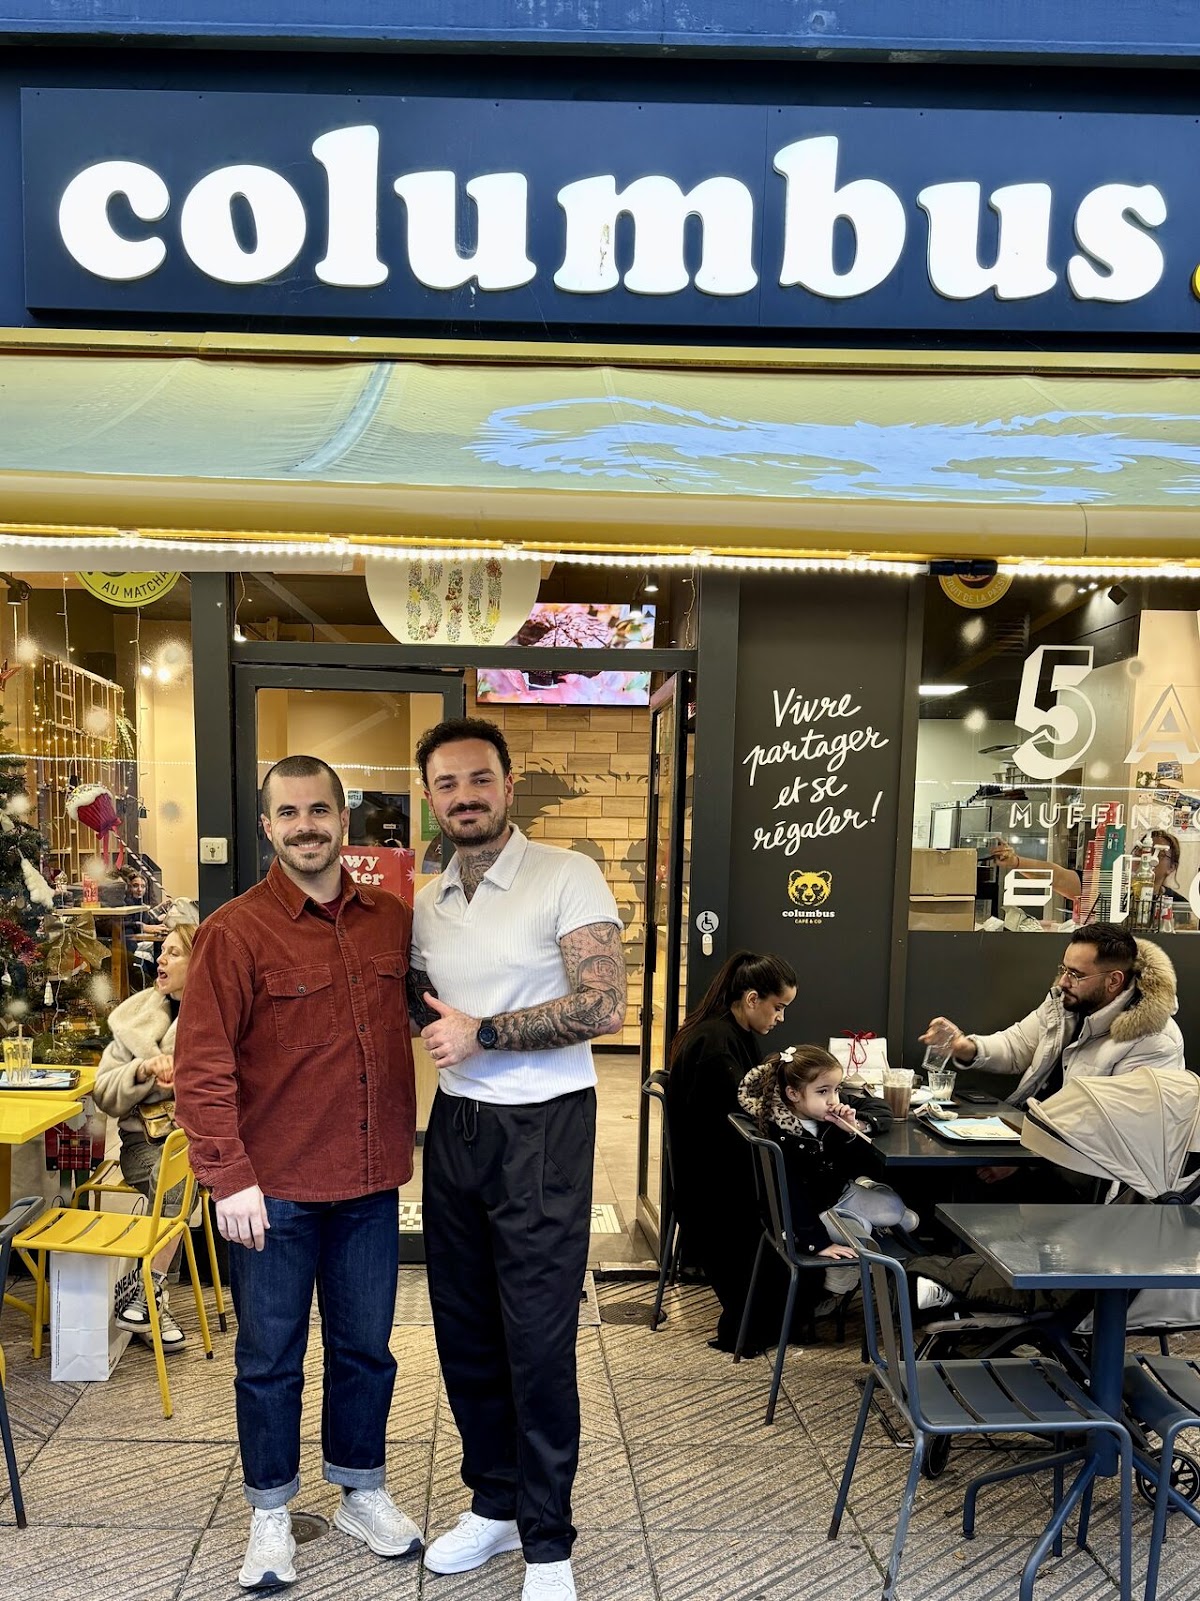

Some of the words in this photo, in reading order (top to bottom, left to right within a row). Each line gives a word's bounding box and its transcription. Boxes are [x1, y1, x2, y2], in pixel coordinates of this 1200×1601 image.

[58, 125, 1167, 303] columbus
[101, 581, 119, 596] AU
[123, 571, 170, 599] MATCHA
[963, 594, 973, 603] DE
[976, 594, 987, 603] LA
[773, 688, 862, 727] Vivre
[1012, 645, 1096, 780] 5
[742, 726, 889, 786] partager
[772, 776, 809, 809] et
[809, 775, 848, 803] se
[1009, 802, 1174, 830] MUFFINS
[340, 855, 379, 871] wy
[350, 870, 384, 885] ter
[782, 909, 836, 918] columbus
[115, 1269, 138, 1300] SNEAK
